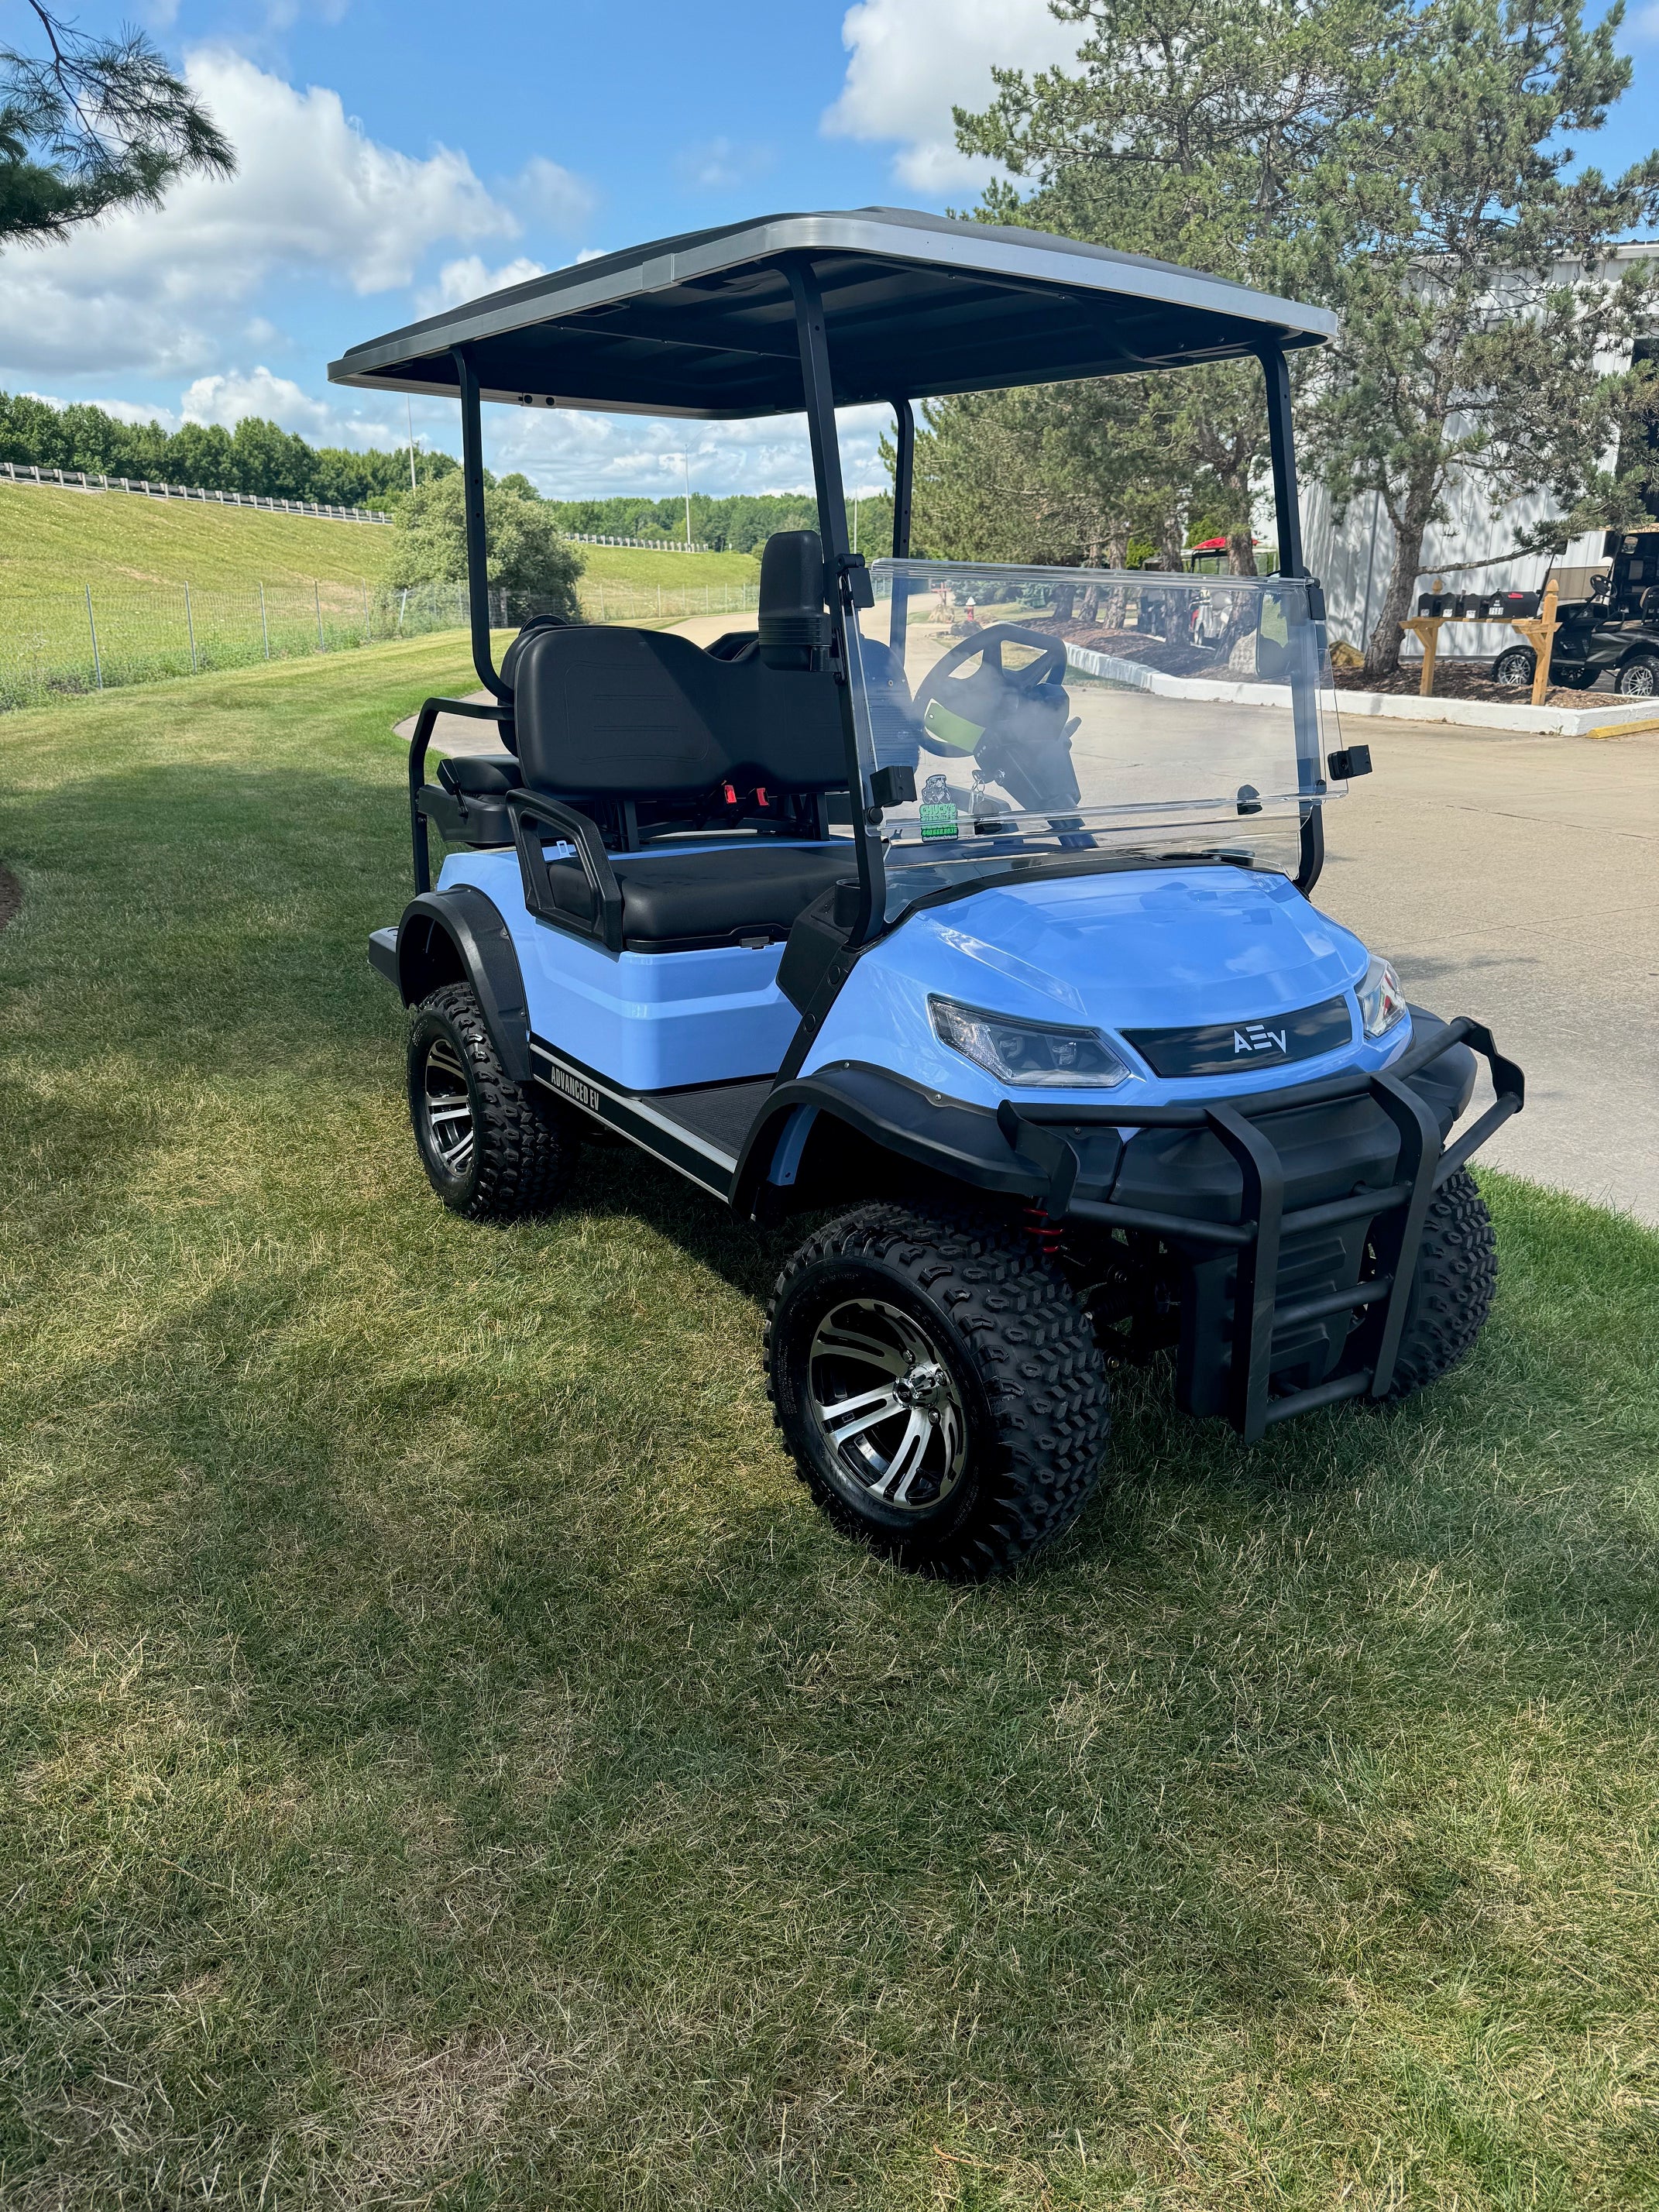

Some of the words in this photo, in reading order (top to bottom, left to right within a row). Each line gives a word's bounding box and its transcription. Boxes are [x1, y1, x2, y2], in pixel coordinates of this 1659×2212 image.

[1233, 1024, 1286, 1054] AEV
[551, 1066, 589, 1104] ADVANCED
[589, 1088, 599, 1111] EV
